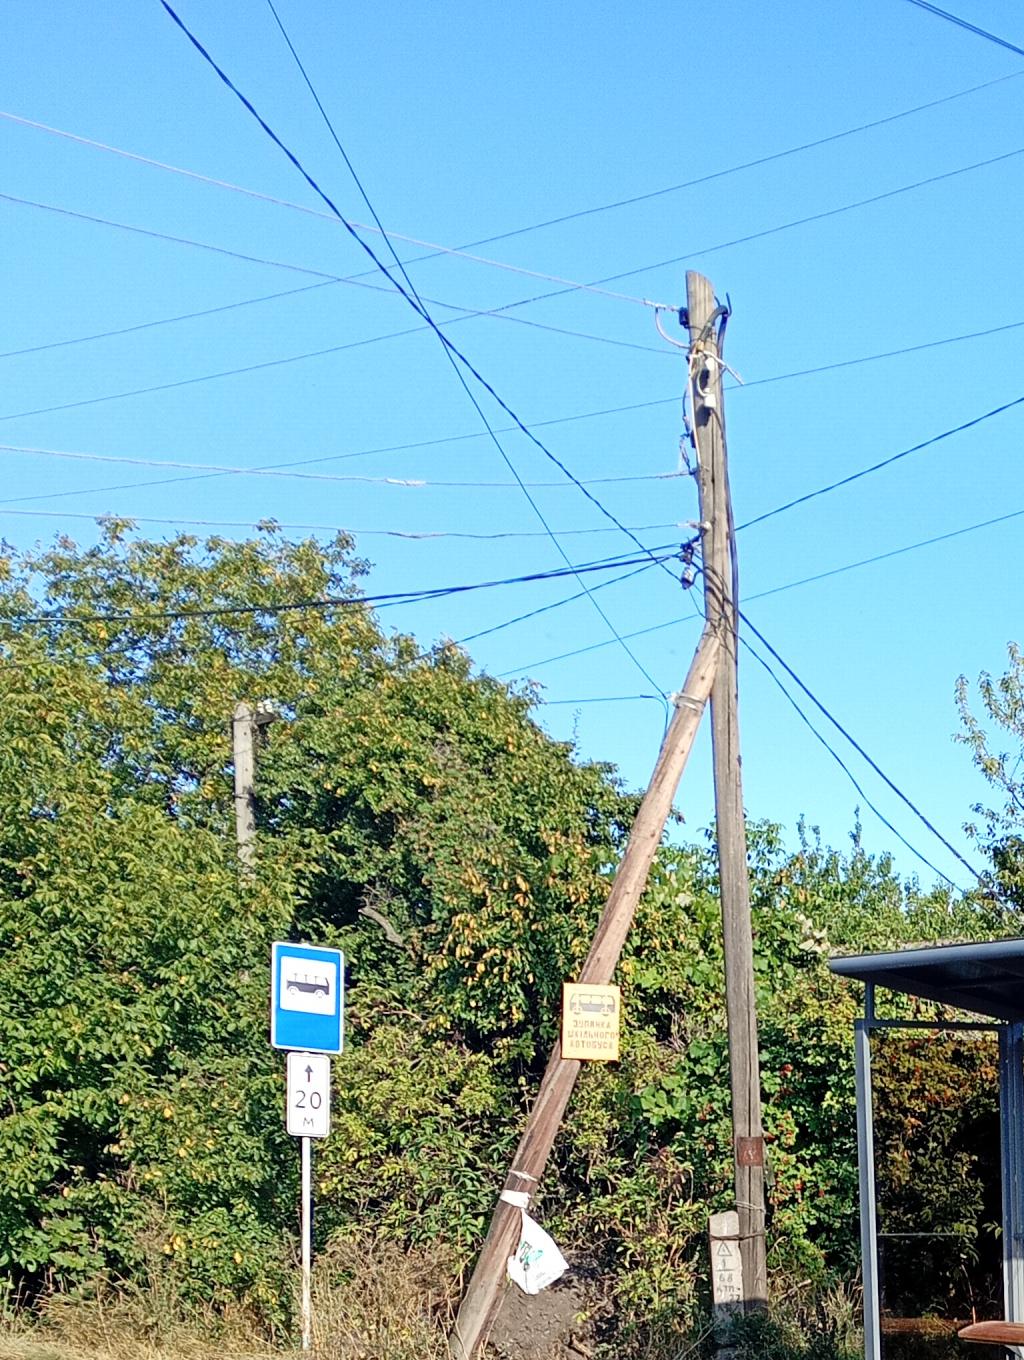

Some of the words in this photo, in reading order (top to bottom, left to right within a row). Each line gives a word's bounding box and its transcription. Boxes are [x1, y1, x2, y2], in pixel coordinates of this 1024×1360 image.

[573, 1019, 611, 1028] ЗУПИНКА
[567, 1030, 615, 1039] ШКІЛЬНОГО
[570, 1040, 613, 1049] АВТОБУСА
[295, 1090, 321, 1109] 20
